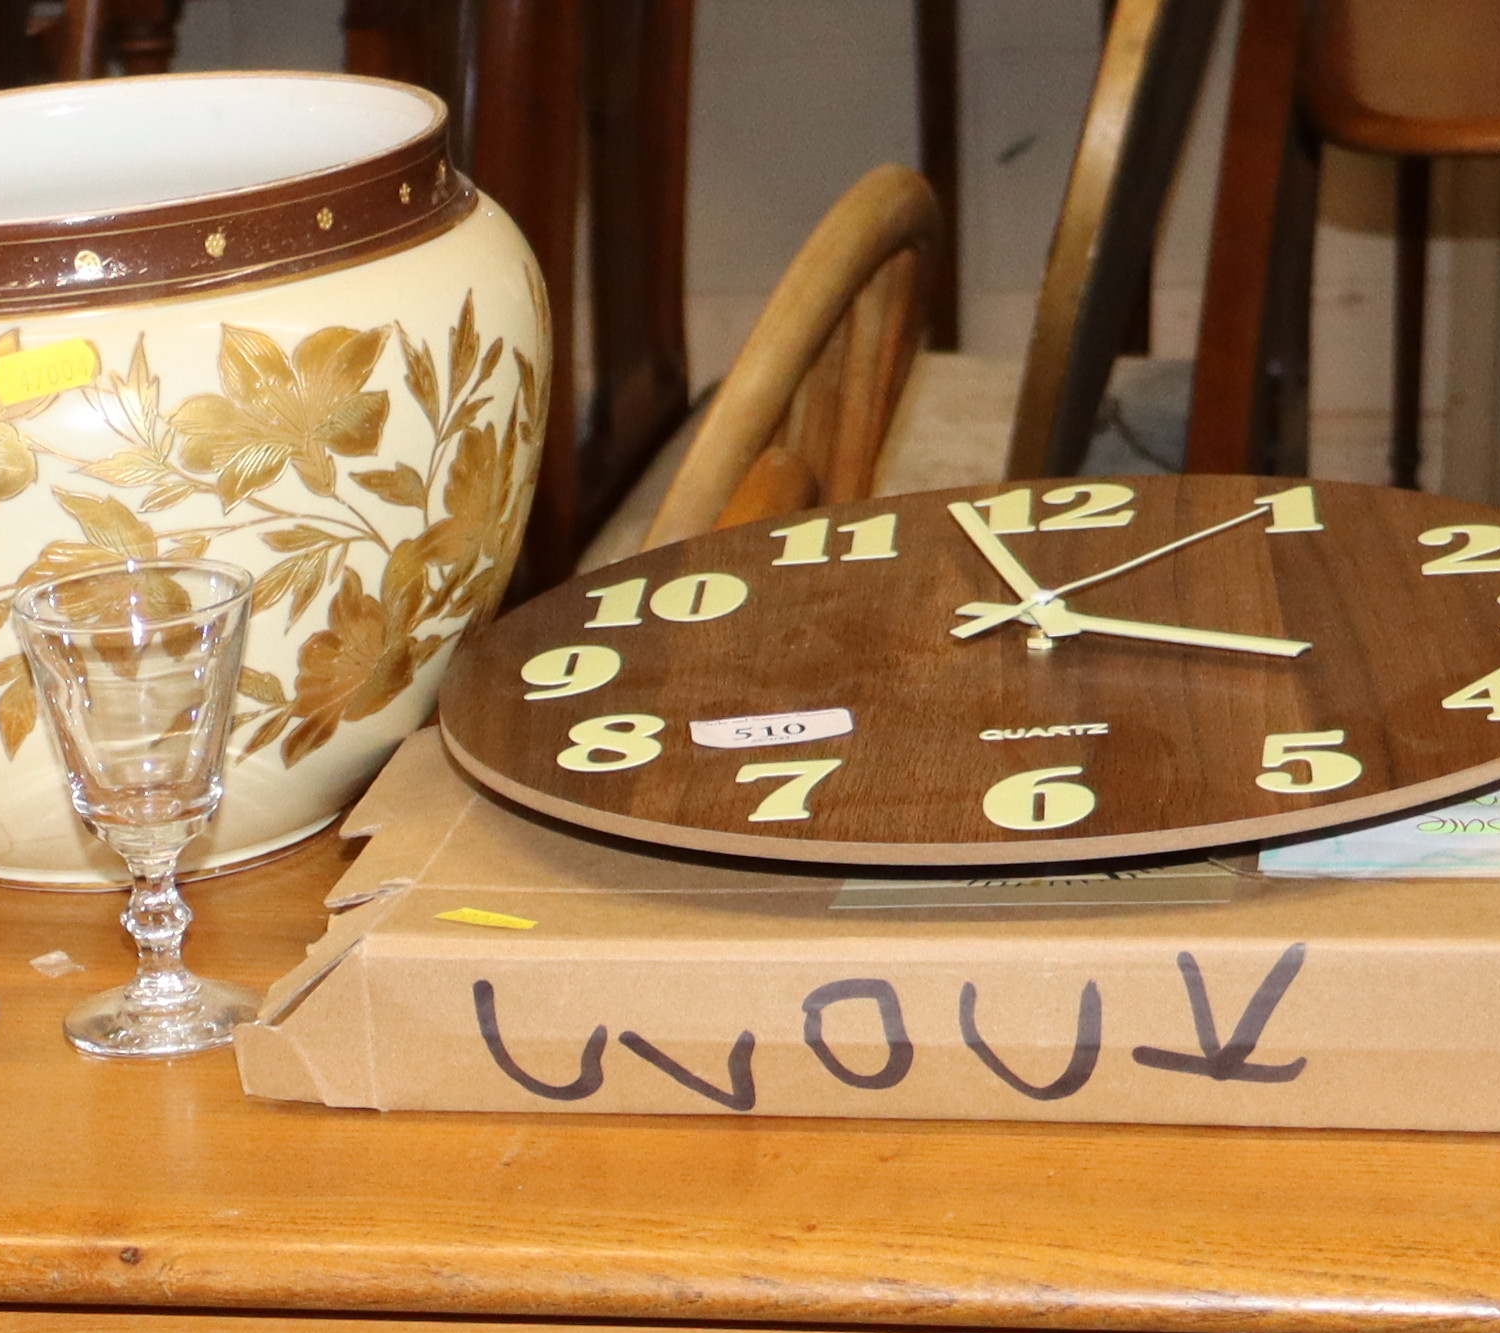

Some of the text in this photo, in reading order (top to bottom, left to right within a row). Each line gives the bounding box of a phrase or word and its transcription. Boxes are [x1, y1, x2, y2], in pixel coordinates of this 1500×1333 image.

[19, 355, 89, 393] 47004
[973, 482, 1136, 535] 12
[1253, 484, 1326, 534] 1
[769, 512, 901, 566] 11
[584, 572, 749, 630] 10
[520, 644, 623, 701] 9
[556, 713, 667, 773] 8
[733, 722, 806, 741] 510
[979, 721, 1110, 742] QUARTZ
[1254, 728, 1364, 794] 5
[734, 758, 843, 823] 7
[982, 765, 1097, 831] 6
